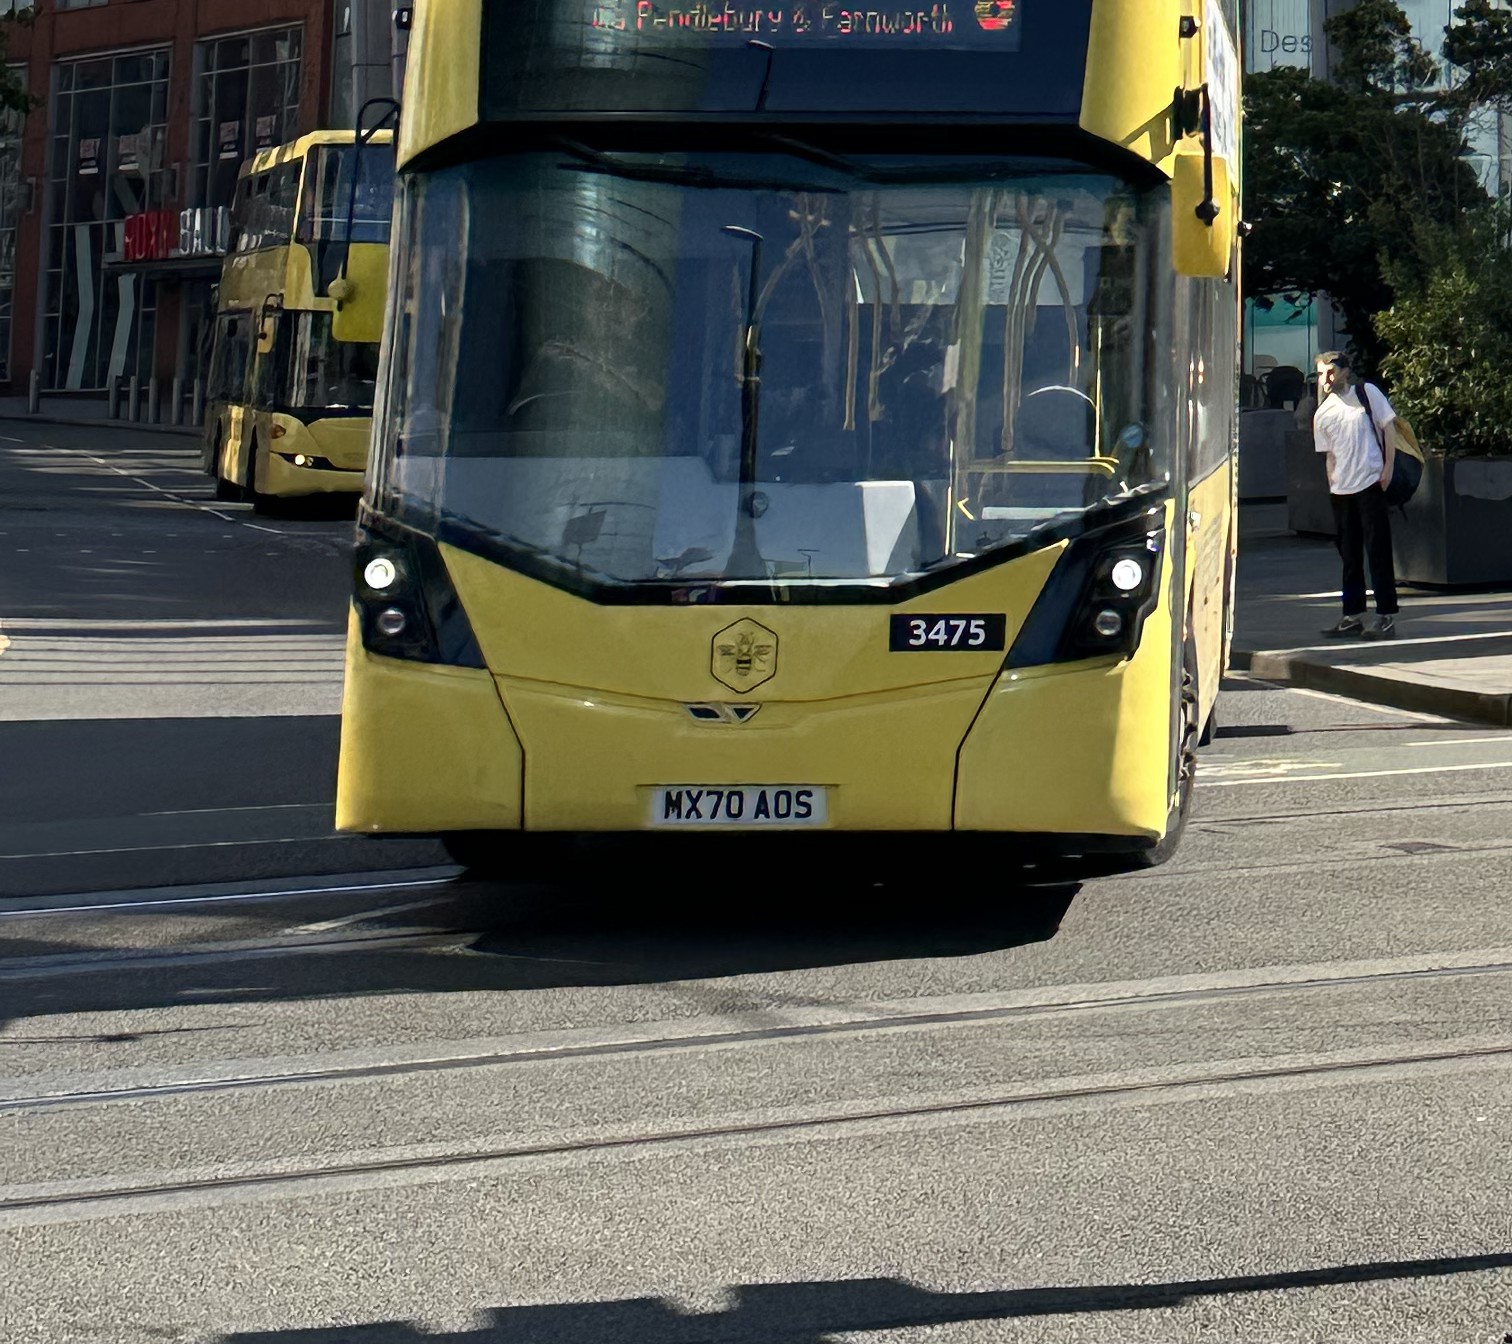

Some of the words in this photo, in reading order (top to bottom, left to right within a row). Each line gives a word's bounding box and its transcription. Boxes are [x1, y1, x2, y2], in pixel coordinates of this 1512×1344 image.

[636, 0, 783, 33] Pendlebury
[821, 2, 953, 35] Farnworth
[908, 619, 986, 646] 3475
[663, 789, 745, 820] MX70
[753, 789, 814, 820] AOS
